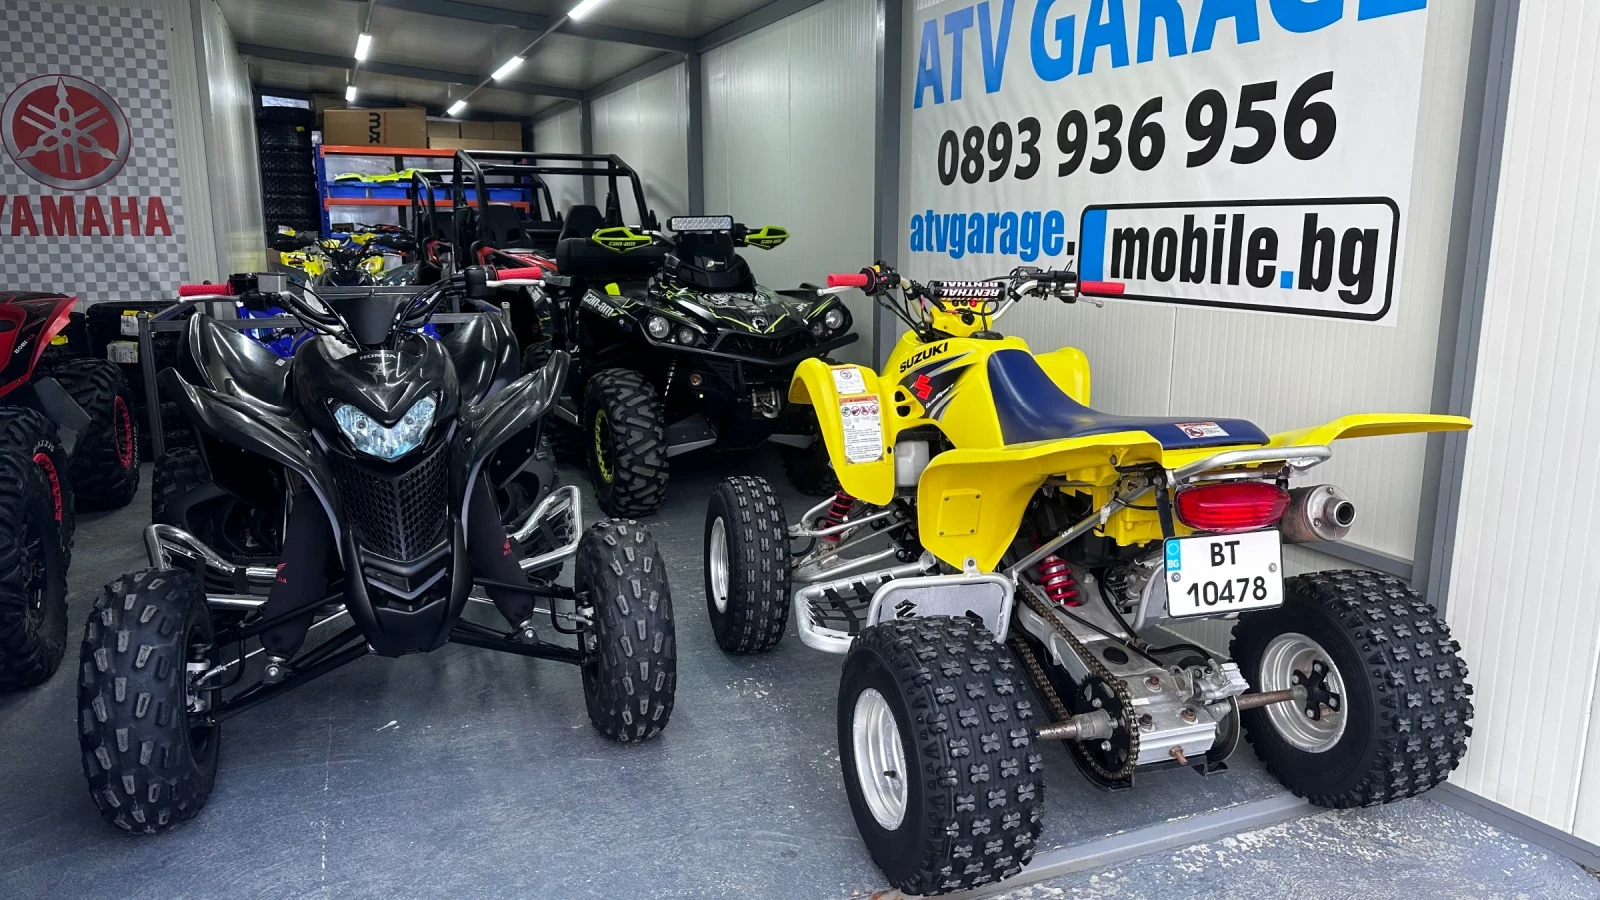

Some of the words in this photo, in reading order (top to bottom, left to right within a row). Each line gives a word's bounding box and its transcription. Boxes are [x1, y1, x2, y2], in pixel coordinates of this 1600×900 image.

[914, 0, 1015, 109] ATV
[1030, 0, 1427, 82] GAR
[937, 116, 1041, 186] 0893
[1057, 96, 1166, 177] 936
[1185, 71, 1337, 168] 956
[0, 195, 173, 237] AMAHA
[1110, 212, 1380, 304] mobile.bg
[583, 293, 615, 318] can-am
[941, 288, 1000, 297] RENTHAL
[900, 342, 949, 373] SUZUKI
[1167, 559, 1180, 568] BG
[1210, 540, 1241, 567] BT
[1187, 576, 1268, 607] 10478
